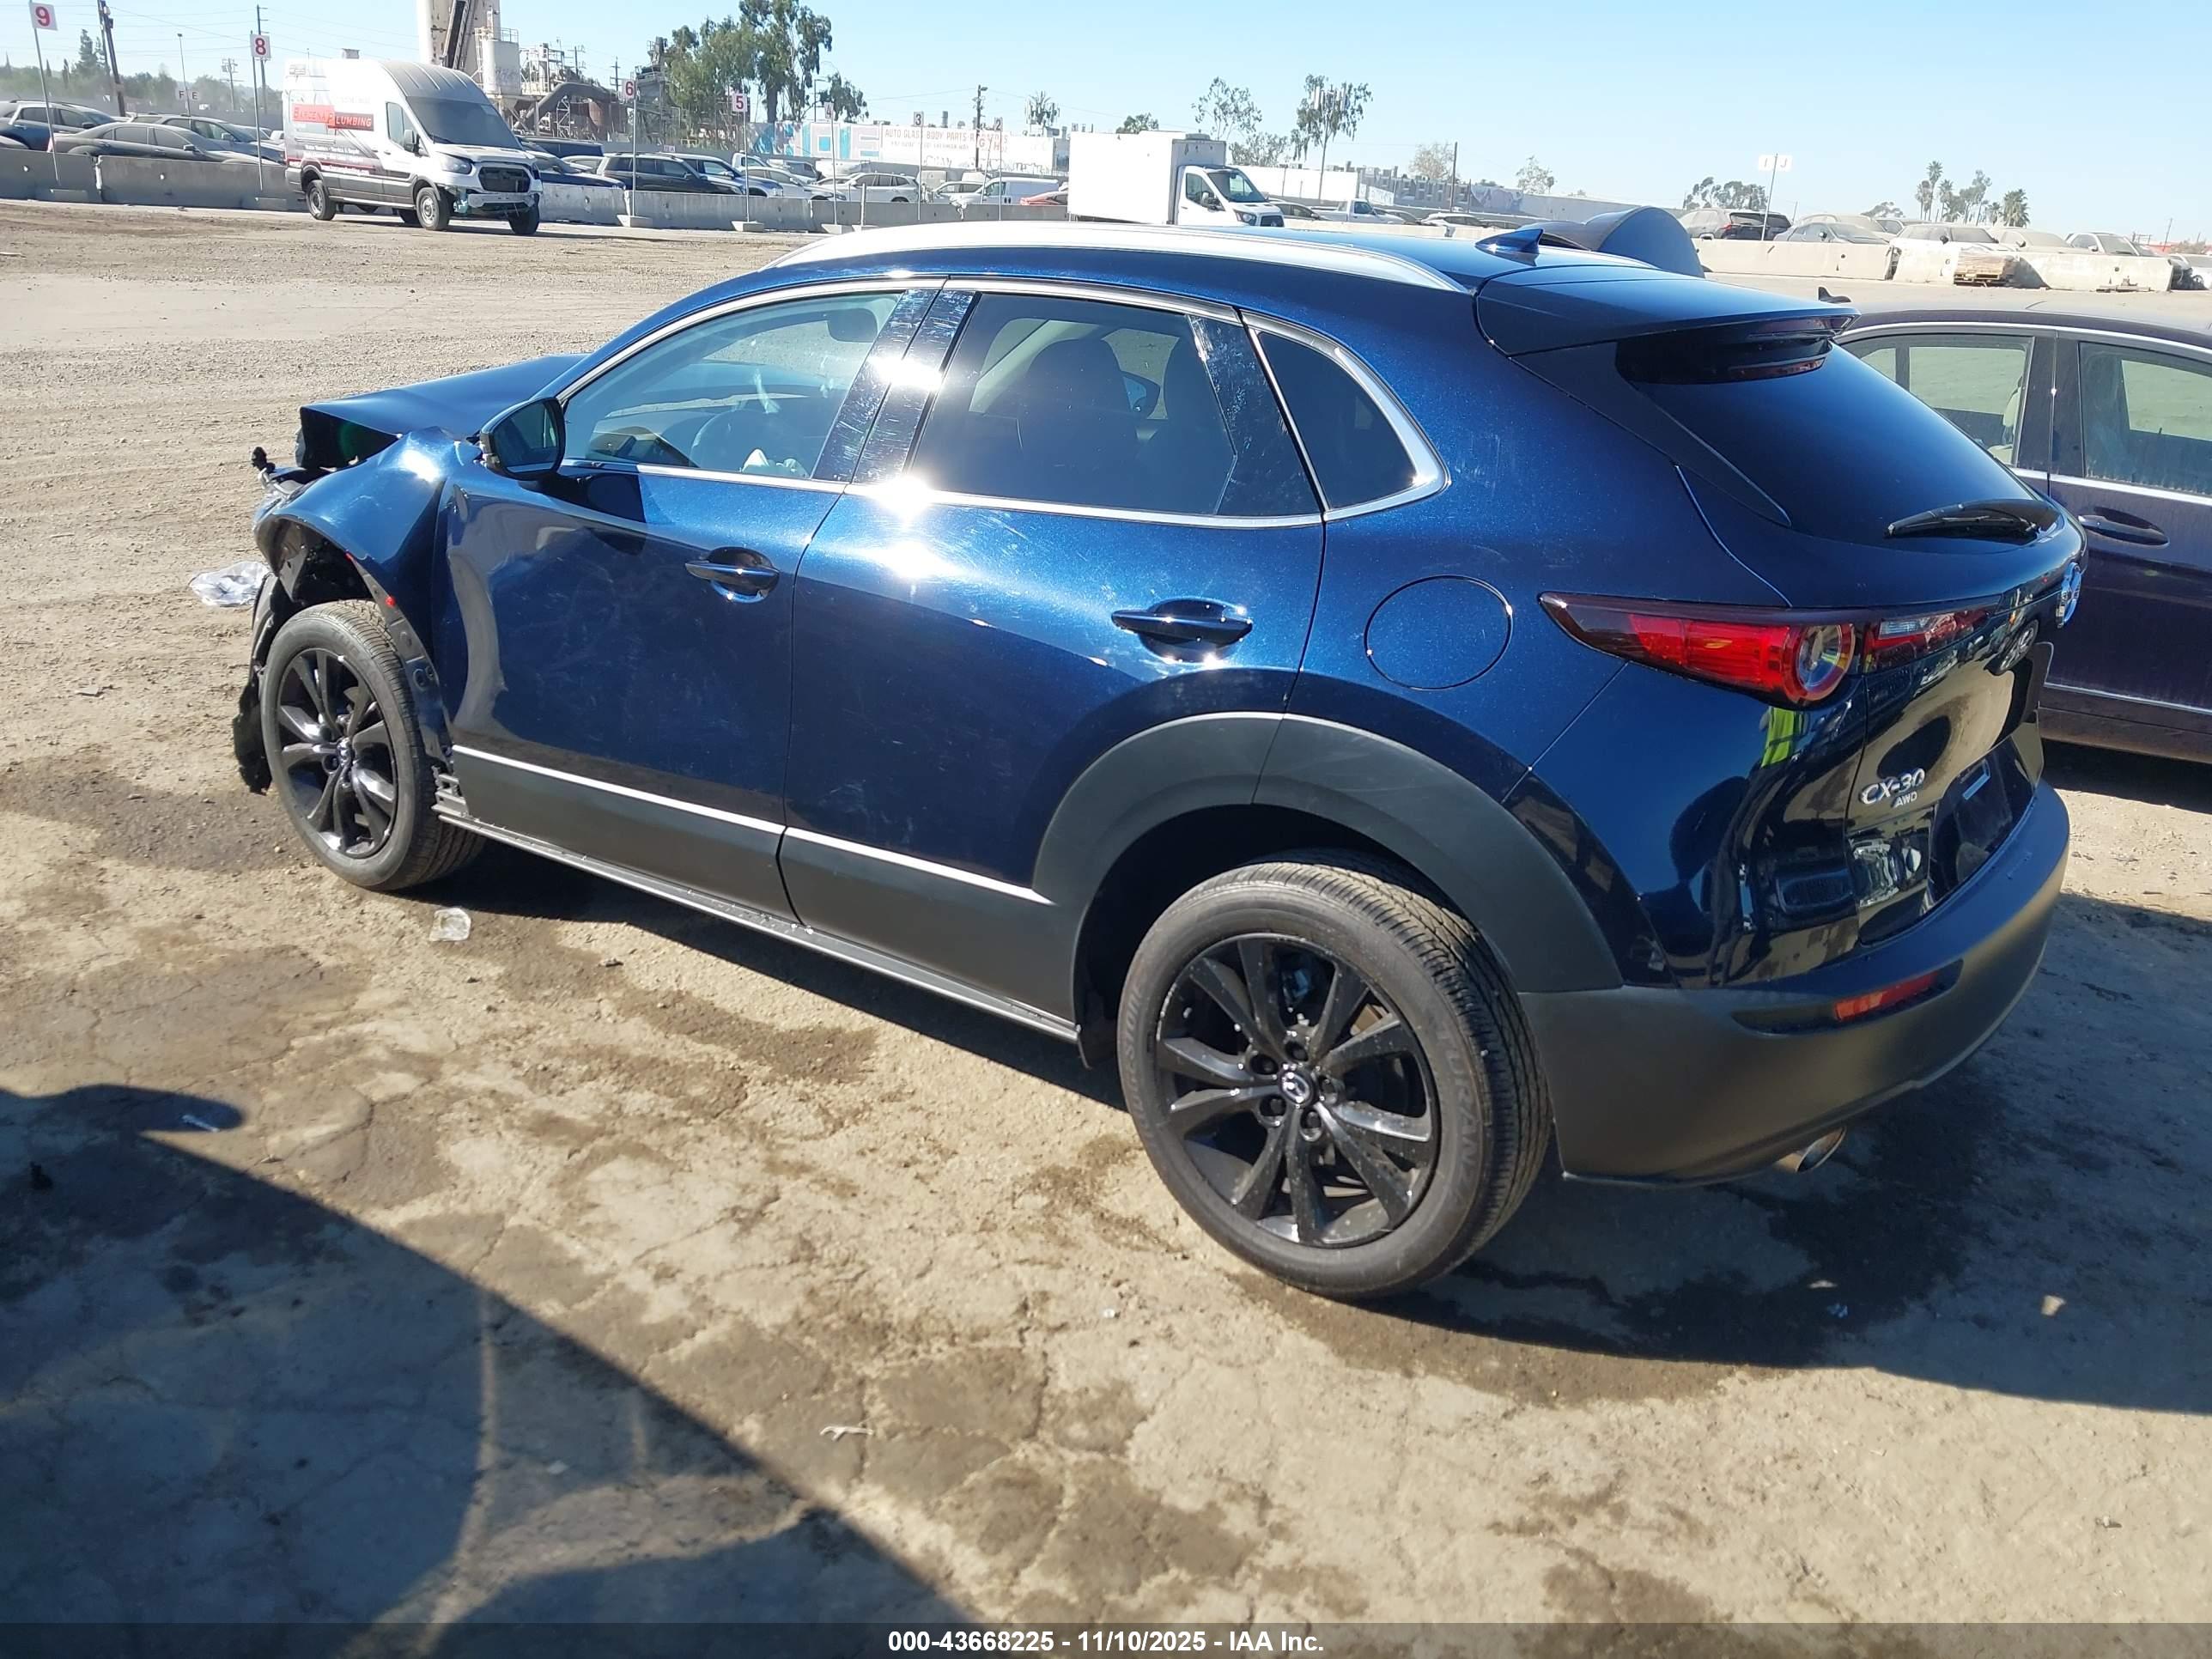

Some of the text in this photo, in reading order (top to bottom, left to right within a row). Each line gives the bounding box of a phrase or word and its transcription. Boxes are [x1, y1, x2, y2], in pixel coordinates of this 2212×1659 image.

[35, 6, 50, 27] 9
[255, 37, 266, 55] 8
[625, 81, 634, 95] 6
[179, 90, 198, 100] F E
[736, 95, 744, 109] 5
[826, 106, 832, 118] 4
[915, 113, 921, 125] 3
[995, 118, 1001, 131] 2
[884, 129, 902, 138] AUTO
[946, 131, 967, 142] PARTS
[1780, 157, 1788, 168] J
[1860, 768, 1925, 805] CX-30
[1893, 791, 1917, 808] AWD
